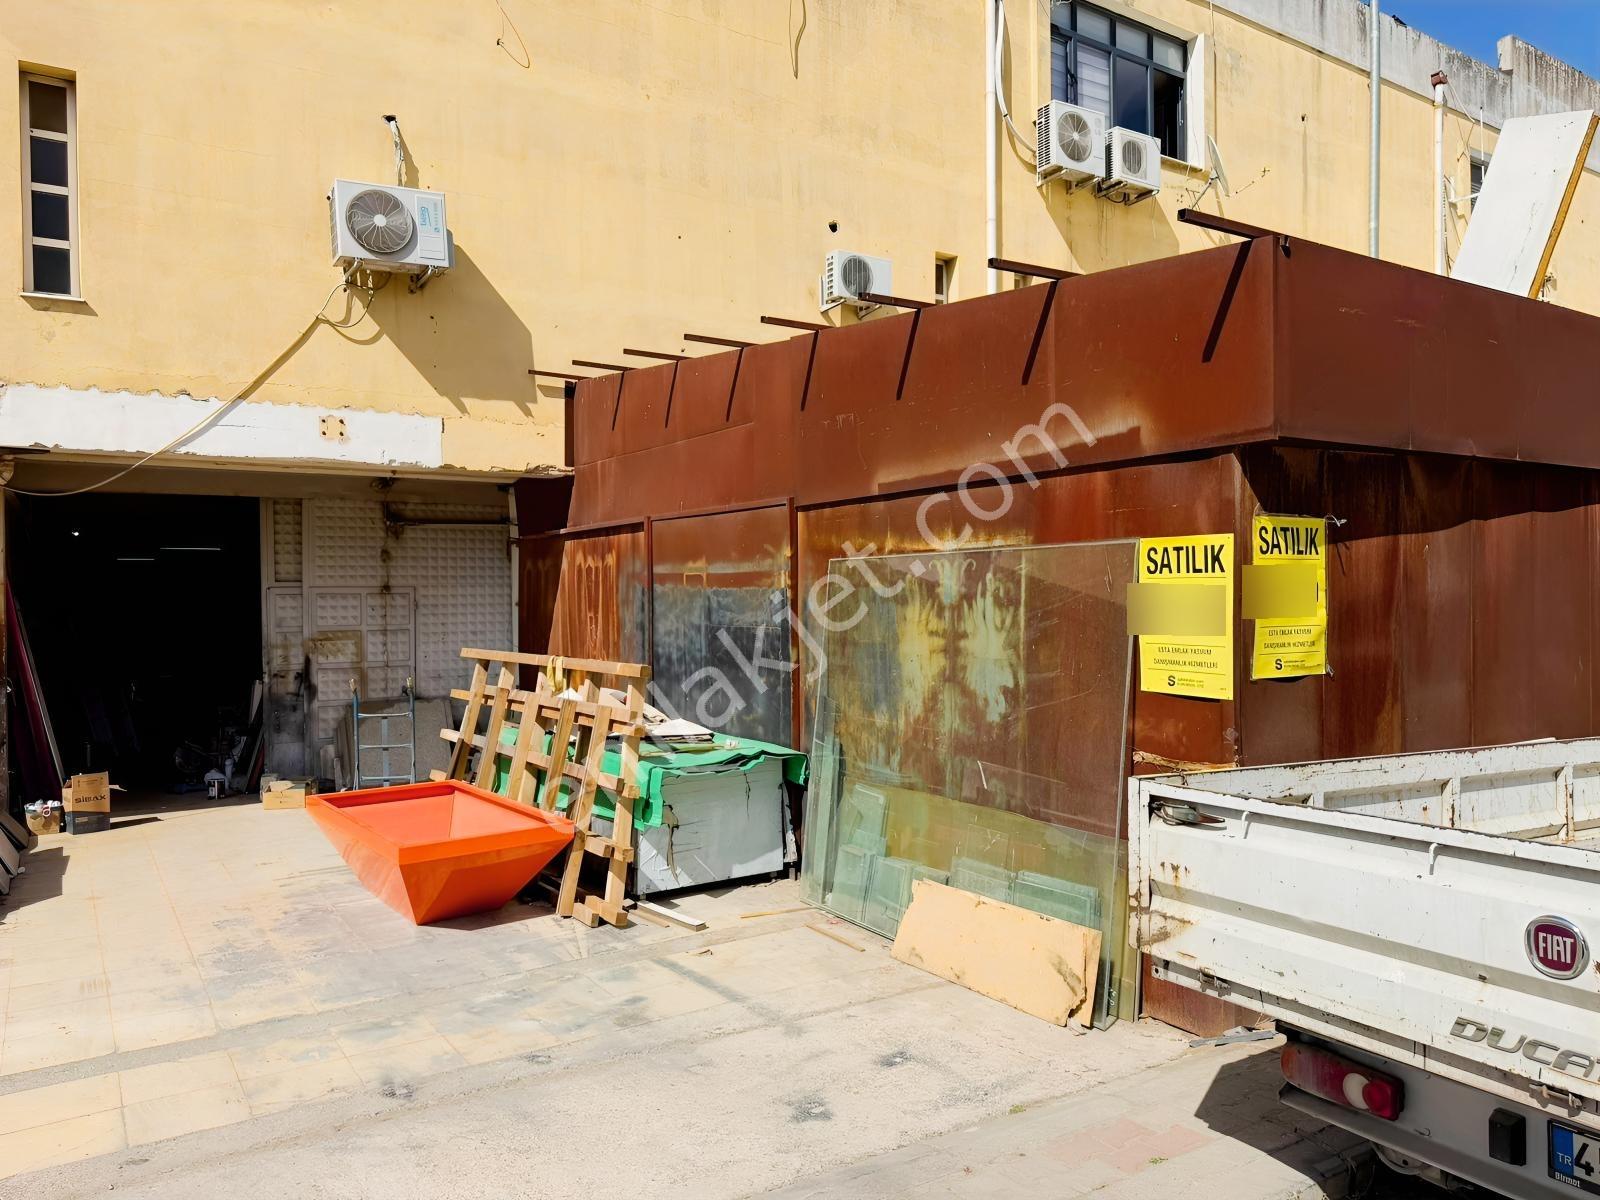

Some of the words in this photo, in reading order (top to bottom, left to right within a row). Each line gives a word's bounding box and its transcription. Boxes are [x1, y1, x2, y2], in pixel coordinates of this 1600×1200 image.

[1258, 525, 1319, 556] SATILIK
[1146, 544, 1226, 575] SATILIK
[1167, 675, 1176, 687] S
[1538, 931, 1575, 964] FIAT
[1450, 1016, 1600, 1081] DUCA
[1556, 1151, 1572, 1167] TR
